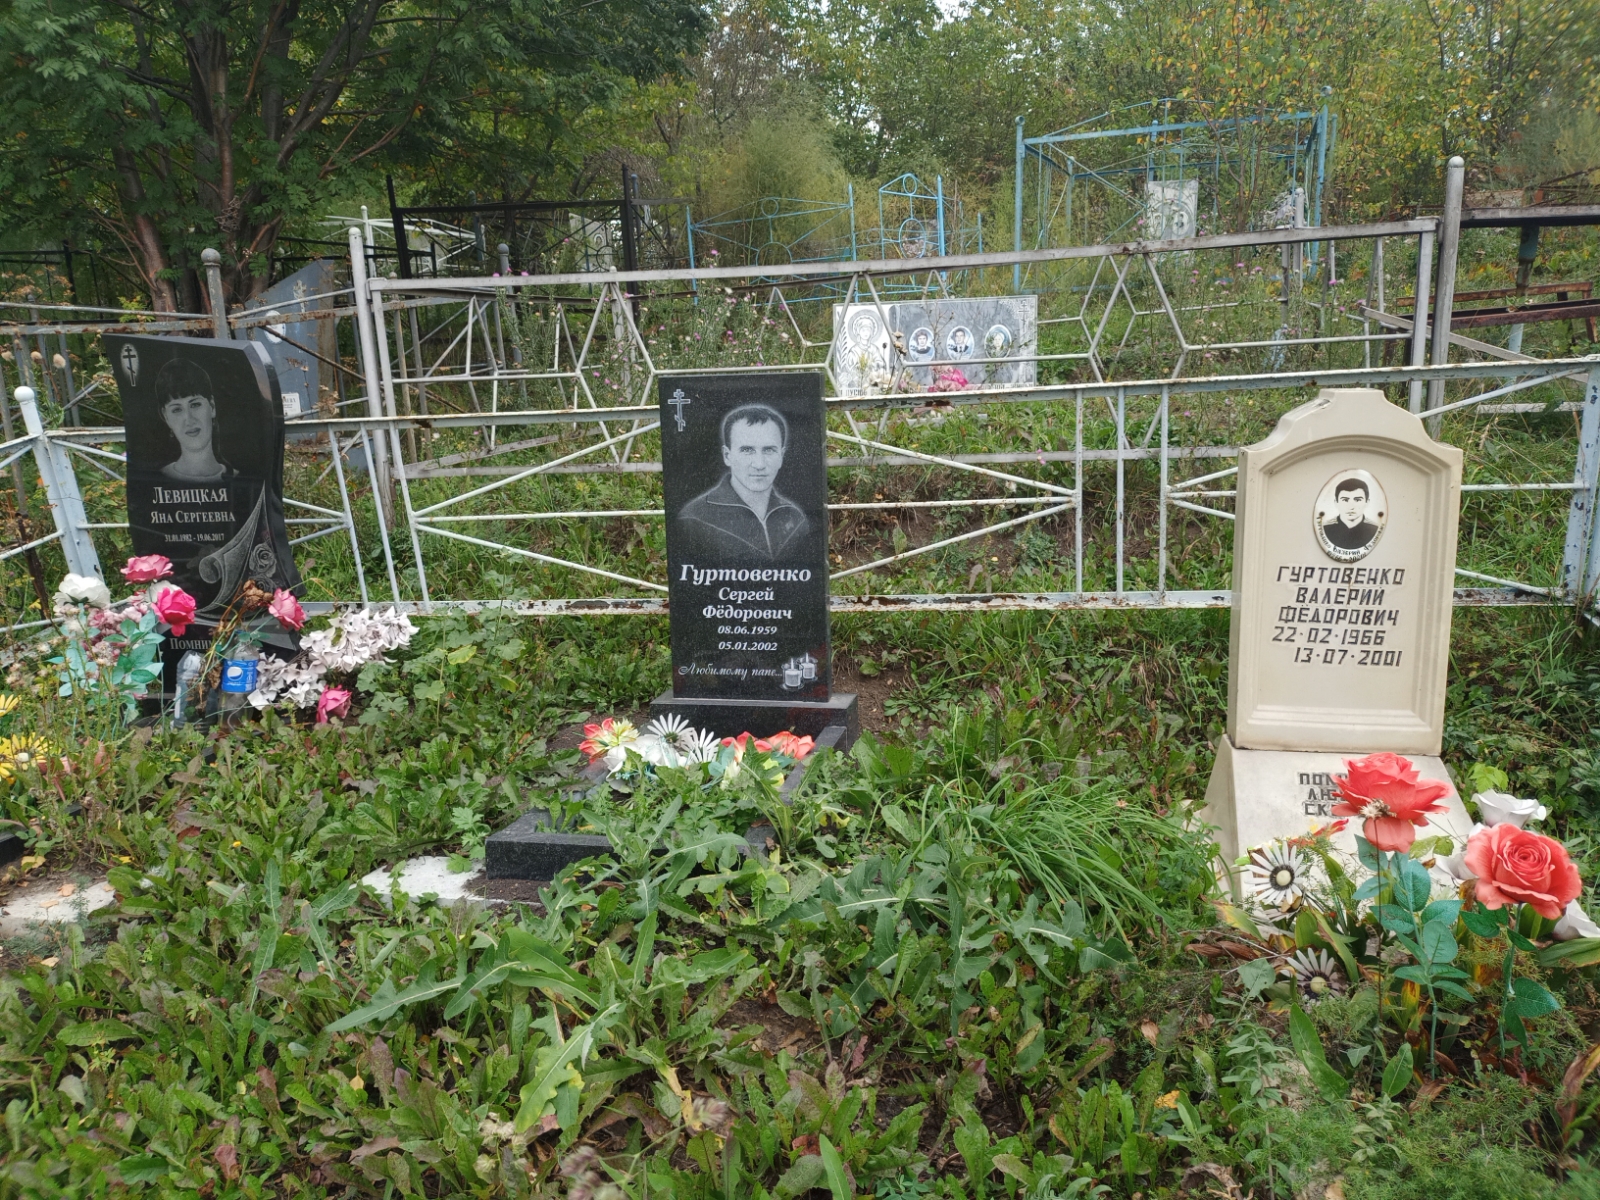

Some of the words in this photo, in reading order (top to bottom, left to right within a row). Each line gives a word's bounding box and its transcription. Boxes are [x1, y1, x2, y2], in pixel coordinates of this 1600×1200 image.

[680, 564, 812, 586] Гуртовенко
[1276, 566, 1406, 585] ГУРТОВЕНКО
[718, 586, 775, 604] Сергей
[1295, 586, 1386, 606] ВАЛЕРИЙ
[702, 604, 793, 622] Фёдорович
[717, 625, 778, 635] 08.06.1959
[718, 641, 778, 651] 05.01.2002
[678, 662, 748, 681] Любимому
